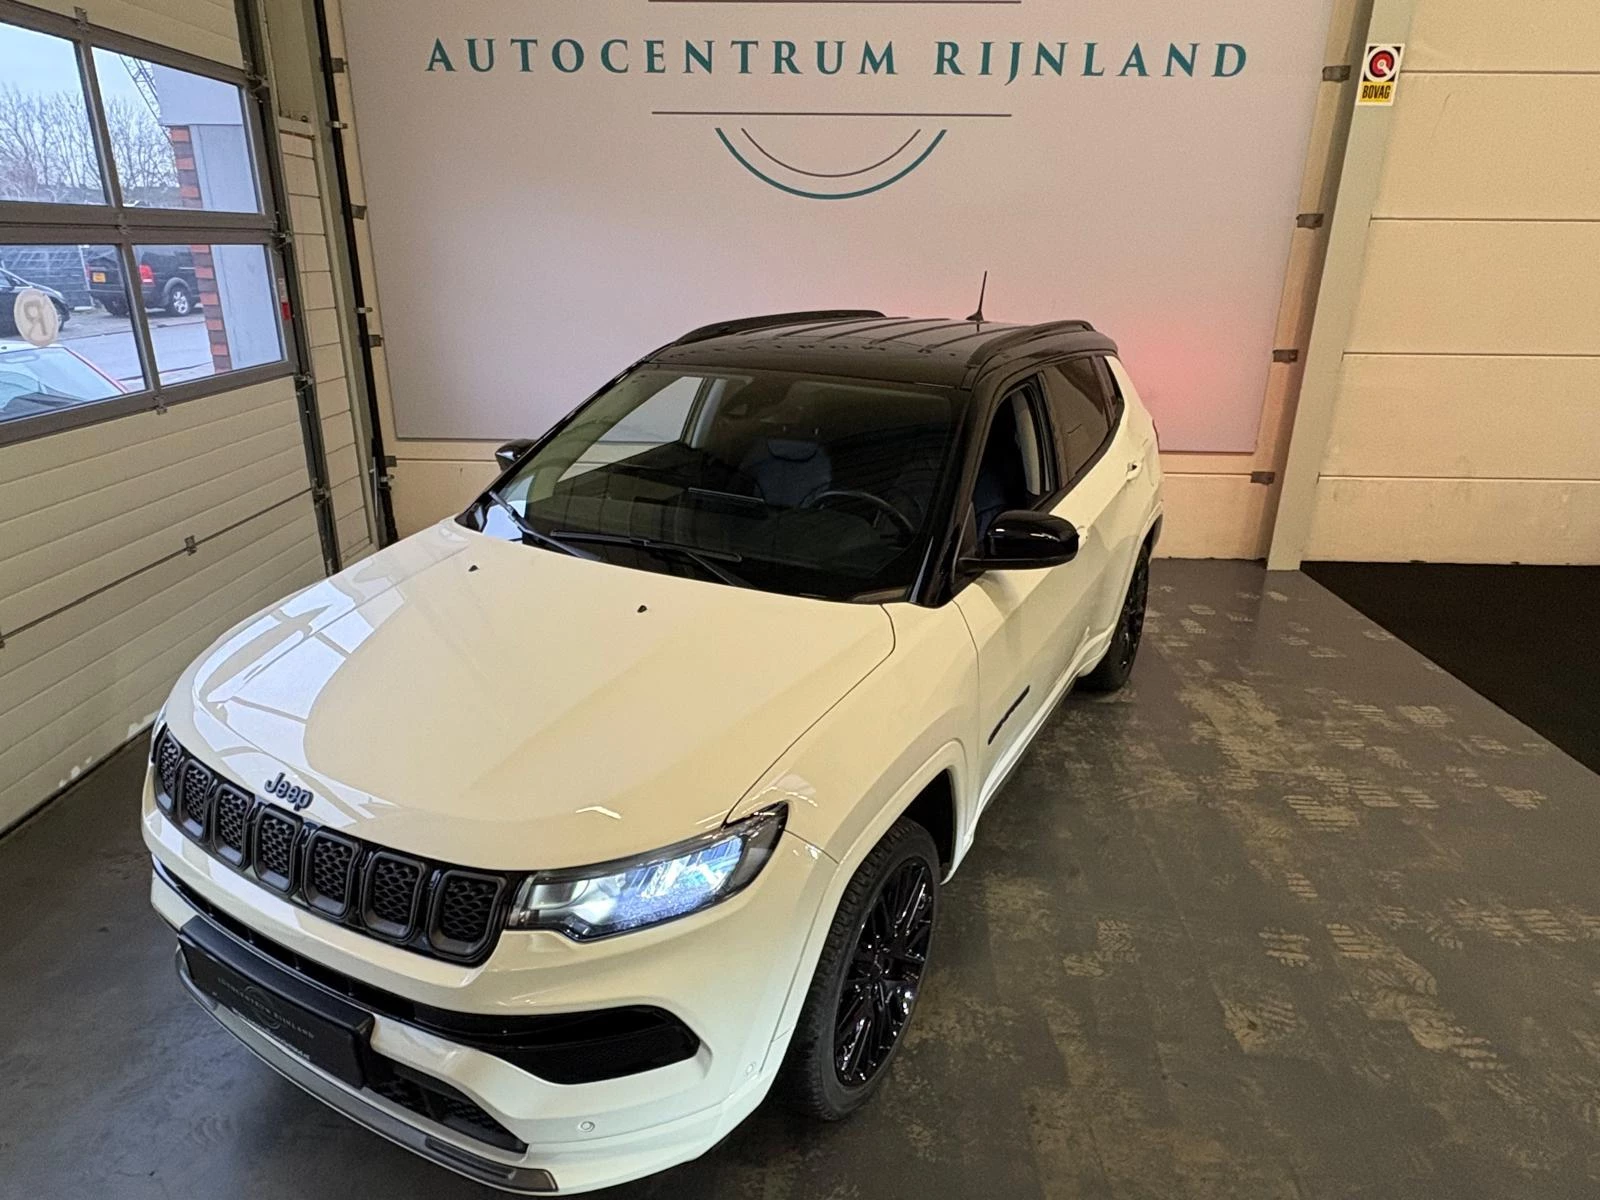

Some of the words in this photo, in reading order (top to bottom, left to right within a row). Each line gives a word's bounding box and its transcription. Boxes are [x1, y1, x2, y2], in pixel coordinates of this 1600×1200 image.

[425, 37, 898, 76] AUTOCENTRUM
[933, 40, 1248, 86] RIJNLAND
[1361, 85, 1392, 100] BOVAG
[264, 772, 314, 812] Jeep
